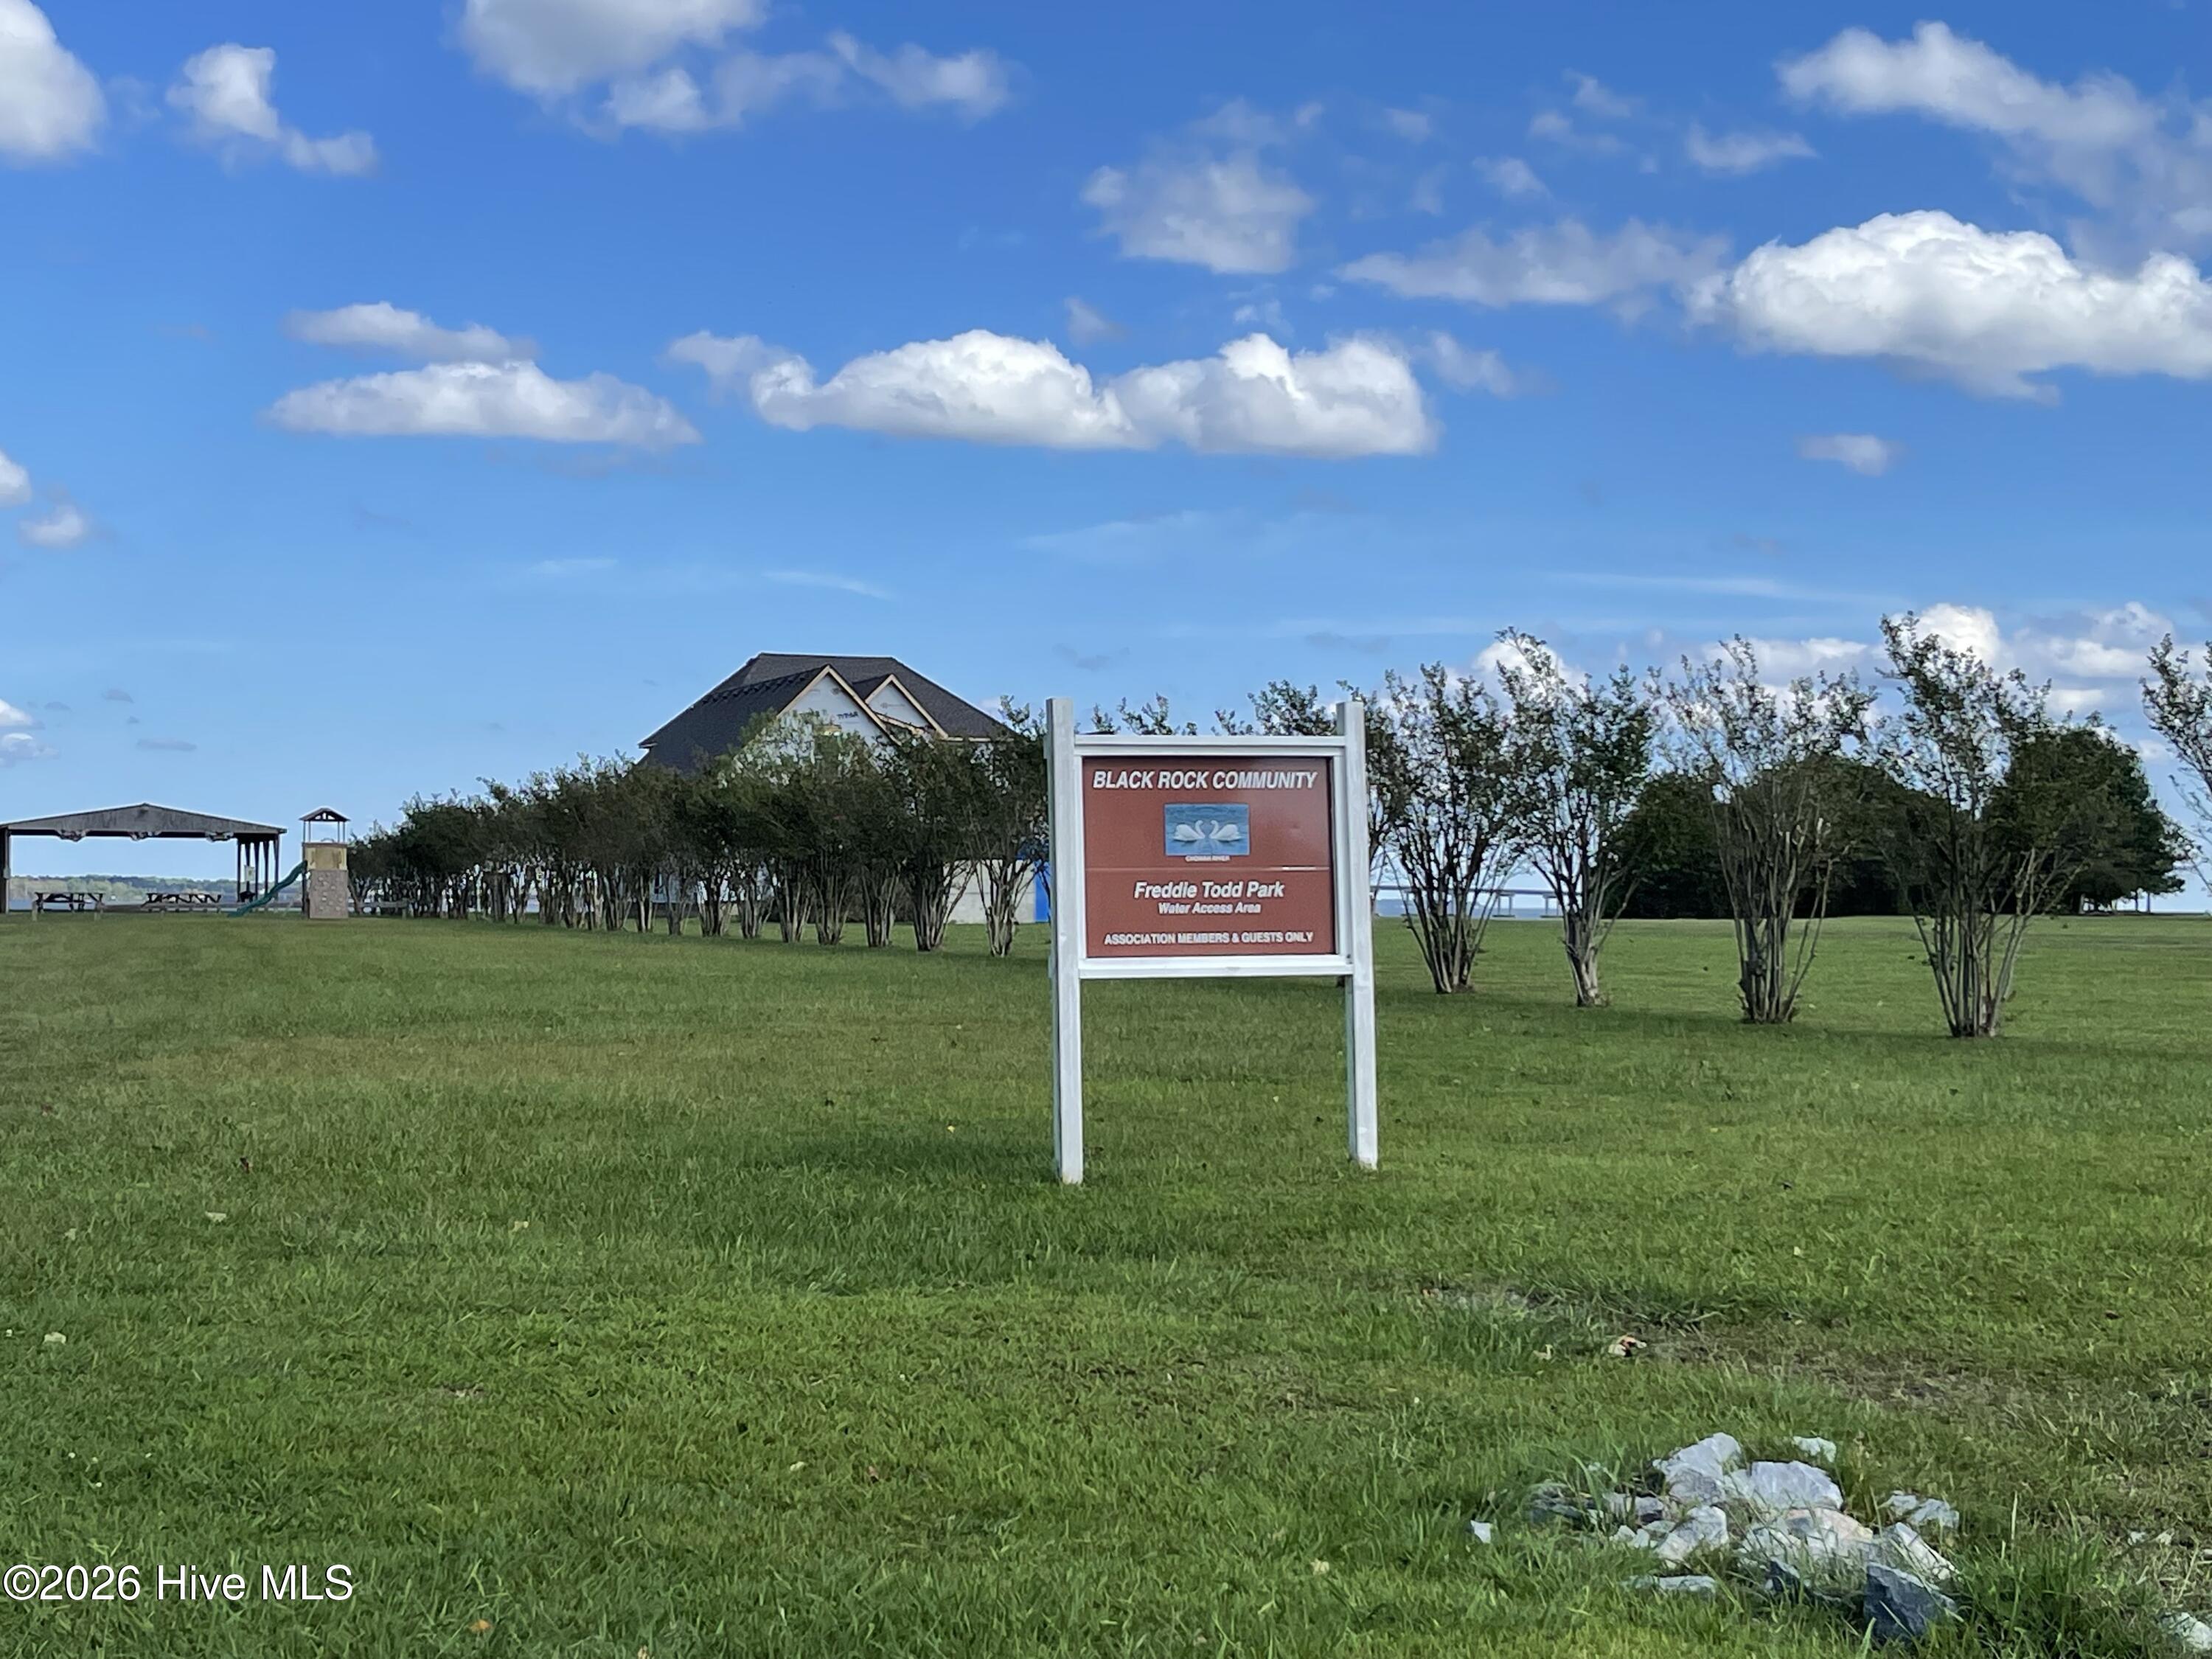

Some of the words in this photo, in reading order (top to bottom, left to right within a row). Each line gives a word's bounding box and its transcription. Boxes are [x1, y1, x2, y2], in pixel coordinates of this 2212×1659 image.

[1093, 771, 1155, 789] BLACK
[1157, 771, 1209, 789] ROCK
[1212, 771, 1318, 789] COMMUNITY
[1134, 881, 1197, 899] Freddie
[1202, 881, 1243, 898] Todd
[1246, 880, 1285, 898] Park
[1158, 902, 1191, 914] Water
[1192, 902, 1233, 914] Access
[1234, 901, 1262, 914] Area
[1104, 933, 1175, 945] ASSOCIATION
[1178, 932, 1230, 944] MEMBERS
[1231, 932, 1239, 944] &
[1241, 931, 1284, 943] GUESTS
[1284, 931, 1313, 942] ONLY
